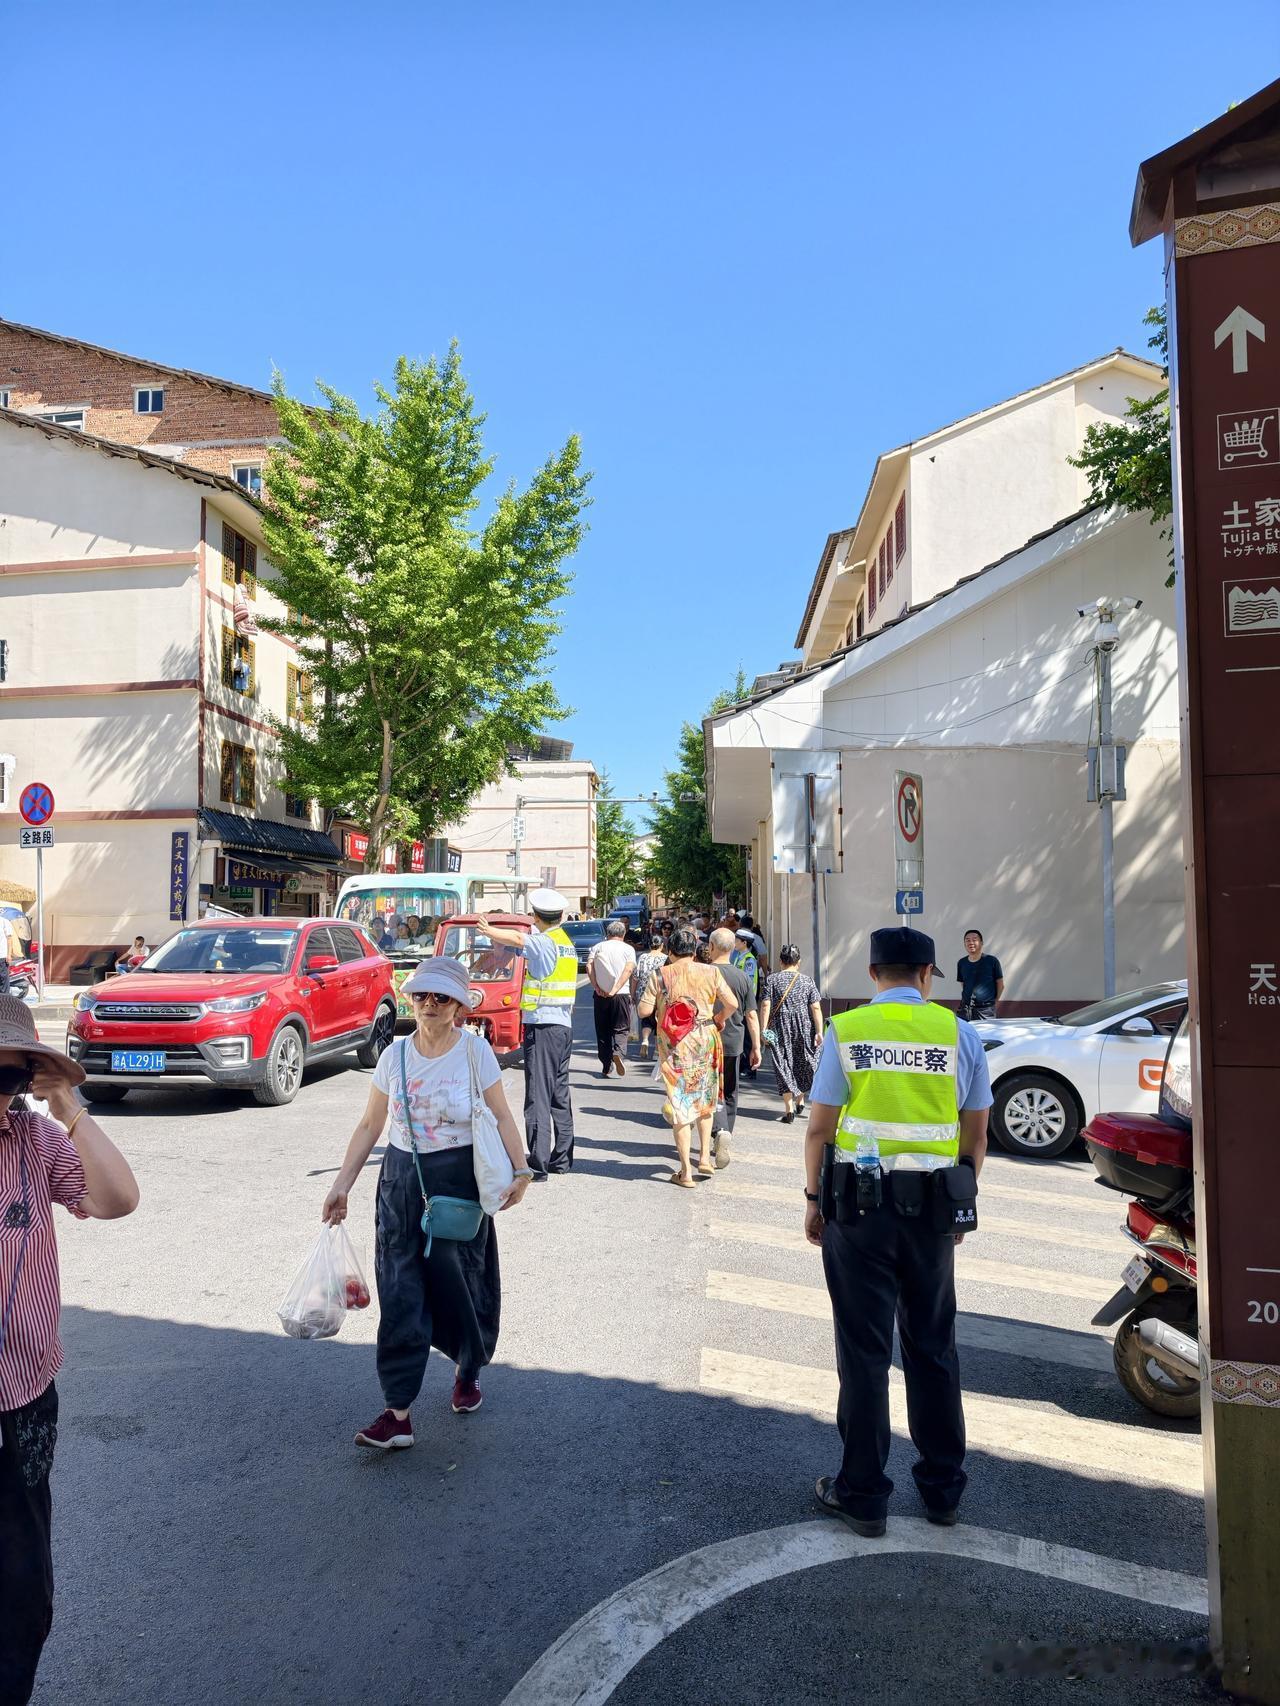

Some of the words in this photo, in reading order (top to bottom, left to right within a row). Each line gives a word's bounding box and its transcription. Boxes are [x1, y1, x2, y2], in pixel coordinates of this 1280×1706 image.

[1220, 529, 1260, 545] Tujia
[22, 830, 52, 845] 全路段
[1247, 1300, 1279, 1324] 20
